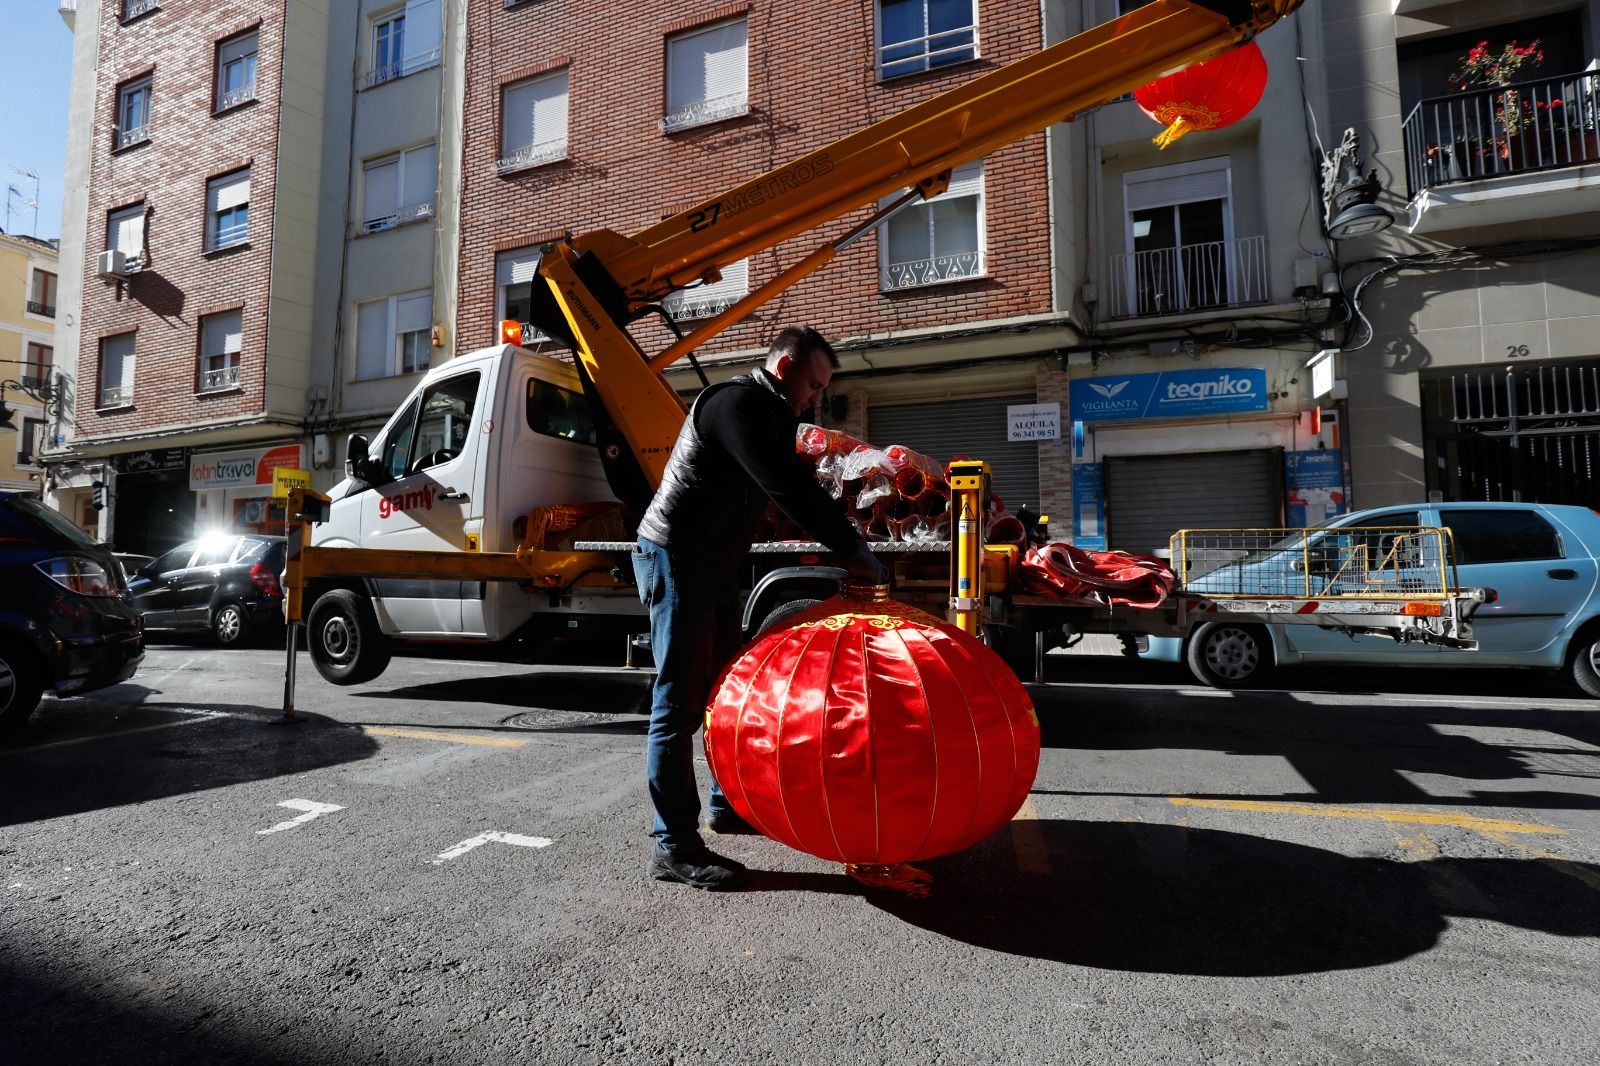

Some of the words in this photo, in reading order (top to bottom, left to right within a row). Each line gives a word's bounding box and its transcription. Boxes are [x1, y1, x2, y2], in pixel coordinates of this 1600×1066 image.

[687, 202, 721, 233] 27
[721, 152, 835, 219] METROS
[567, 288, 601, 332] RUTHMANN
[1506, 344, 1530, 358] 26
[1082, 399, 1138, 410] VIGILANTA
[1013, 420, 1056, 430] ALQUILA
[1037, 429, 1046, 437] 98
